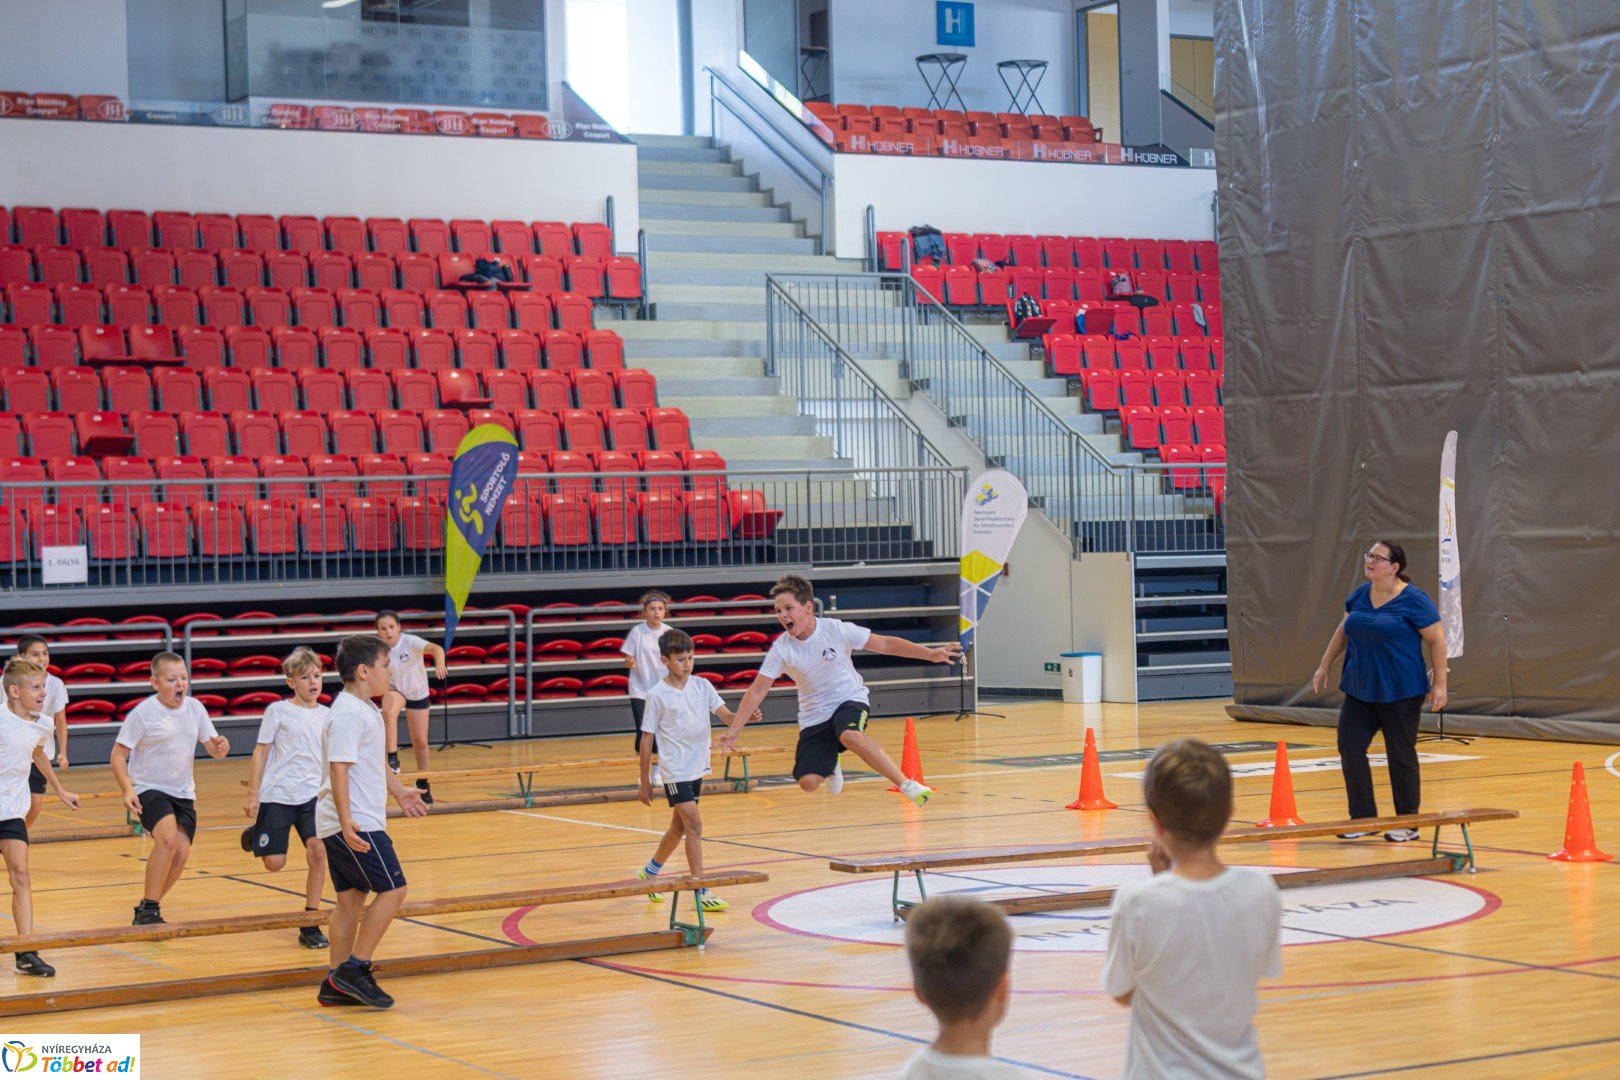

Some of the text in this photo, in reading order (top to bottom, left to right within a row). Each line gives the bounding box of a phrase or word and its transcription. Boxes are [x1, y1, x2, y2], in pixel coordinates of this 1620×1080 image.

[443, 118, 463, 131] BH
[1048, 149, 1093, 161] HÜBNER
[1121, 147, 1178, 165] H HÜBNER
[480, 452, 511, 504] SPORTOLÓ
[485, 475, 507, 517] NEMZET
